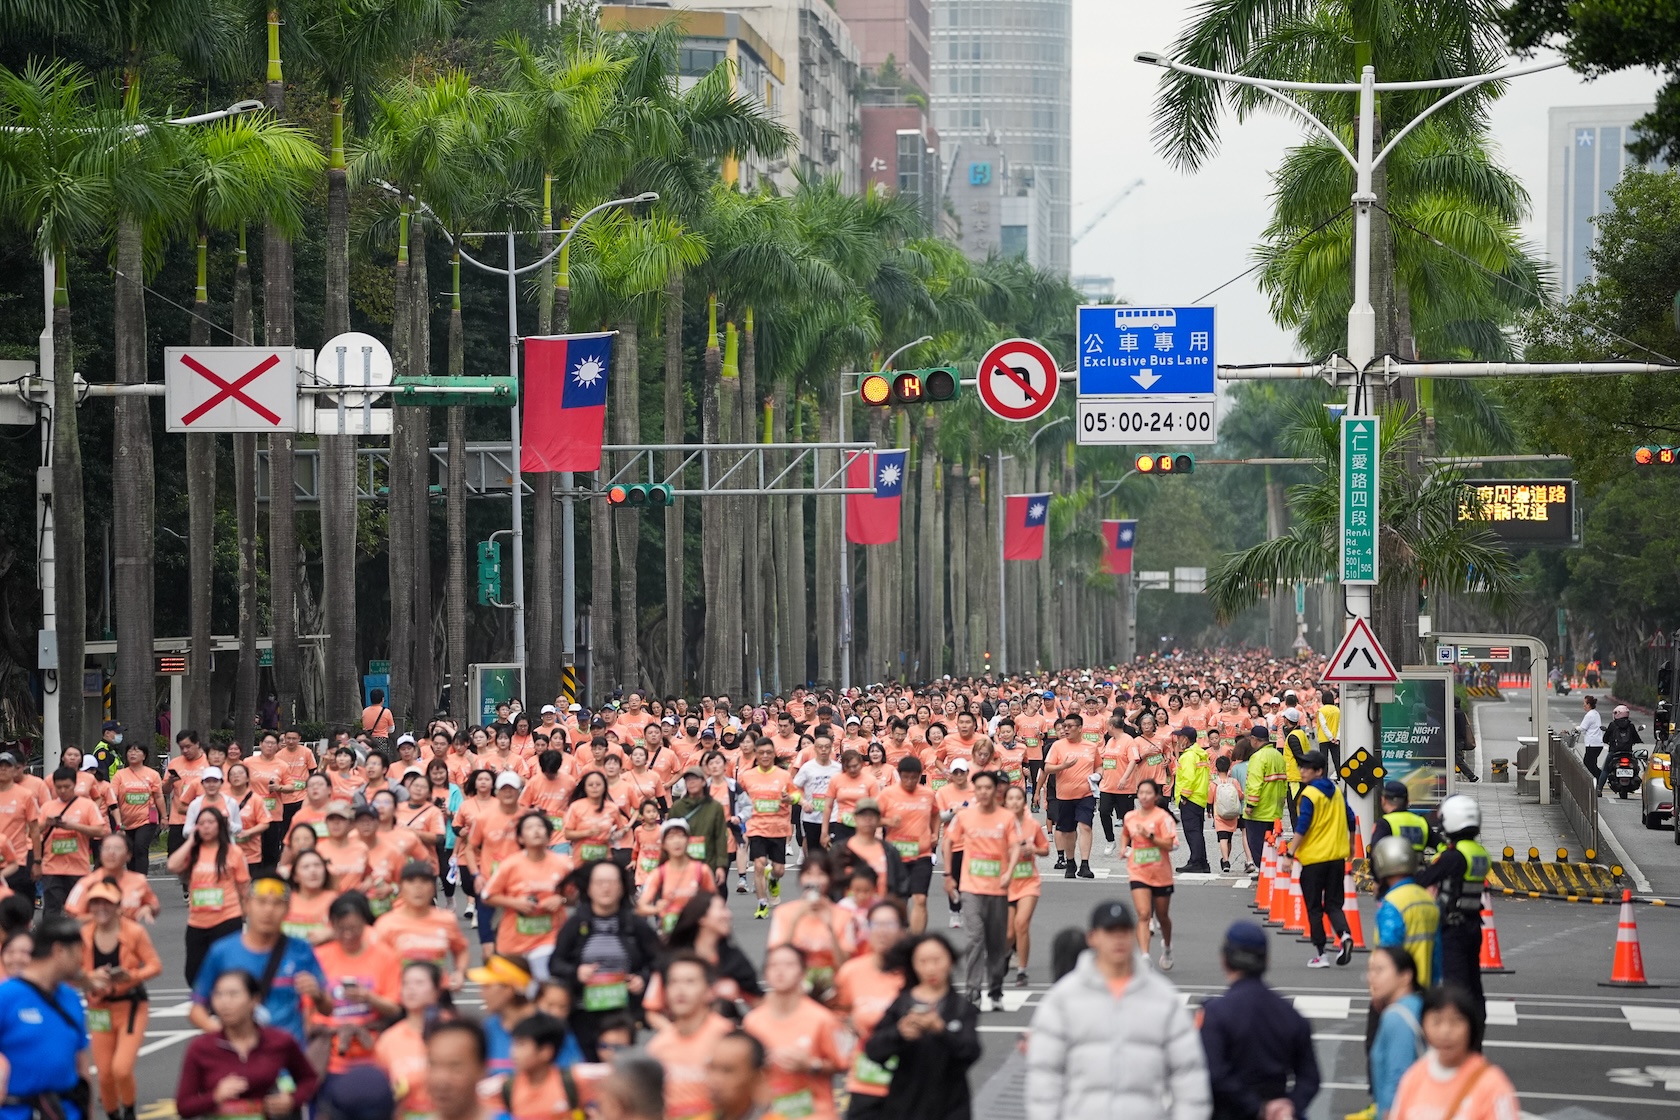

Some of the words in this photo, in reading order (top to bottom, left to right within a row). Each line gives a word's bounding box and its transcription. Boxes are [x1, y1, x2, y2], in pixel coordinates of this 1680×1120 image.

[1084, 332, 1209, 354] 公車專用
[1083, 355, 1147, 367] Exclusive
[1150, 355, 1174, 366] Bus
[1177, 354, 1209, 365] Lane
[903, 378, 921, 397] 14
[1084, 411, 1210, 432] 05:00-24:00
[1161, 456, 1172, 471] 18
[1351, 435, 1368, 526] 仁愛路四段
[1345, 528, 1371, 537] RenAi
[1345, 538, 1359, 547] Rd.
[1346, 547, 1364, 556] Sec.
[1365, 547, 1373, 556] 4
[1360, 563, 1372, 573] 505
[1345, 570, 1357, 579] 510
[1412, 726, 1441, 735] NIGHT
[1381, 730, 1410, 744] 夜跑
[1410, 735, 1430, 744] RUN
